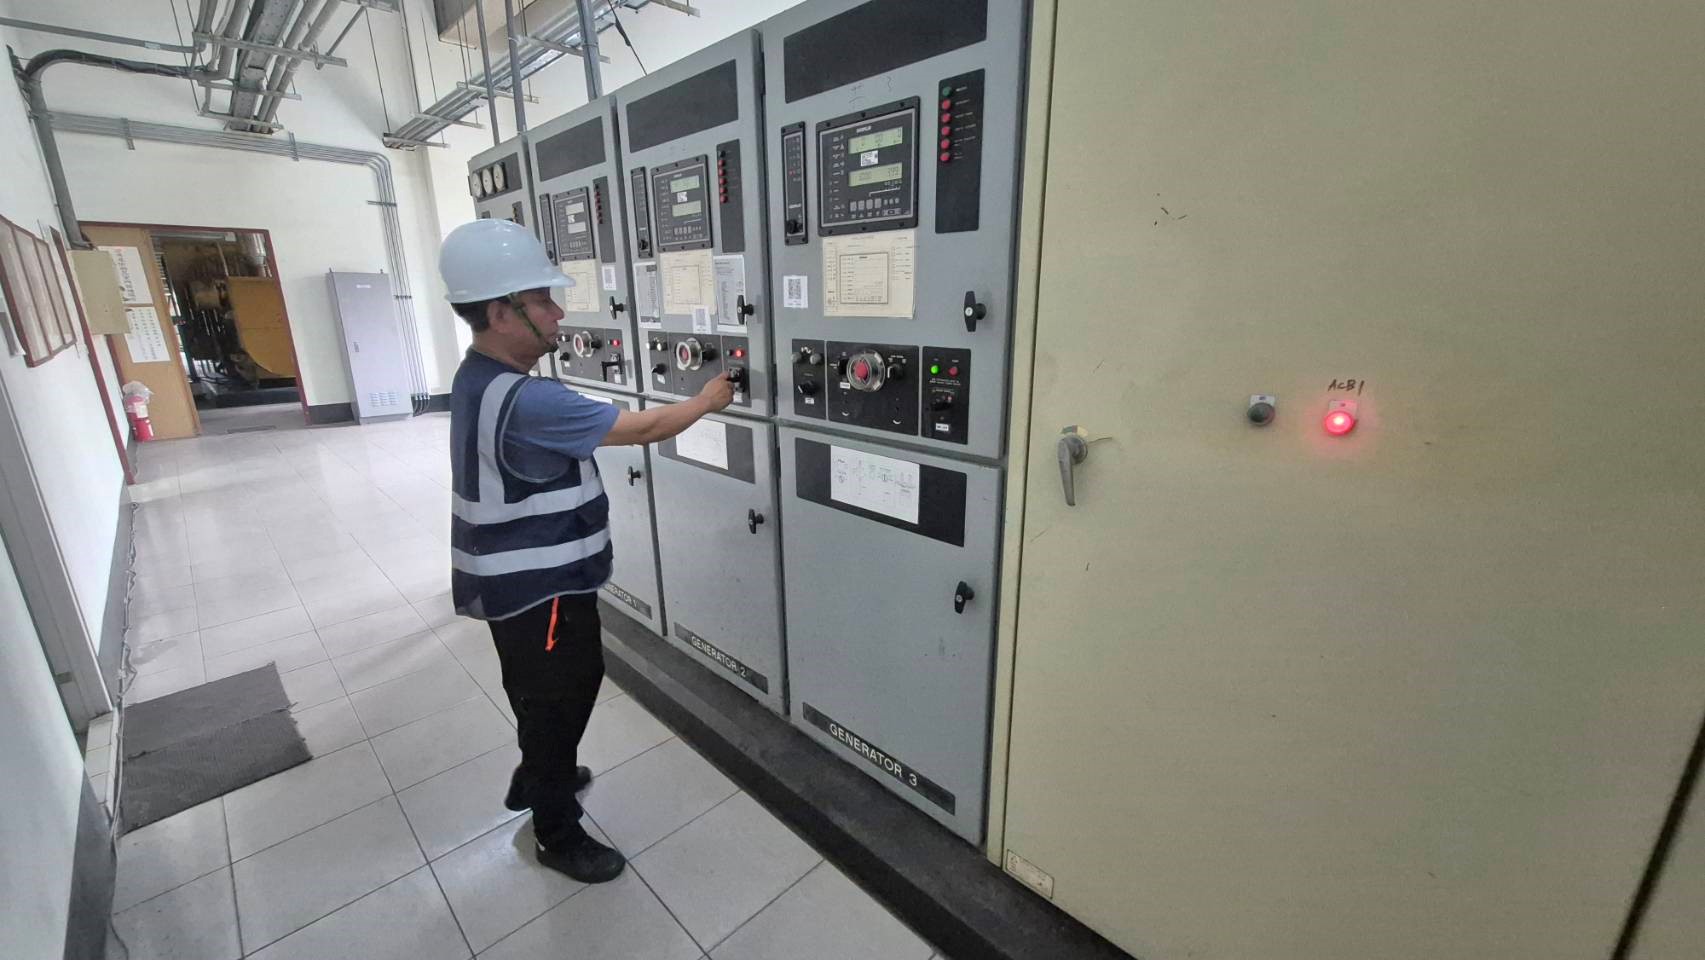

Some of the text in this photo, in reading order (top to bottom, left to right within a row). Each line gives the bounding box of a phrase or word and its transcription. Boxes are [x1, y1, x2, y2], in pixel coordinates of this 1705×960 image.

[691, 635, 747, 678] GENERATOR 2
[829, 723, 918, 786] GENERATOR 3
